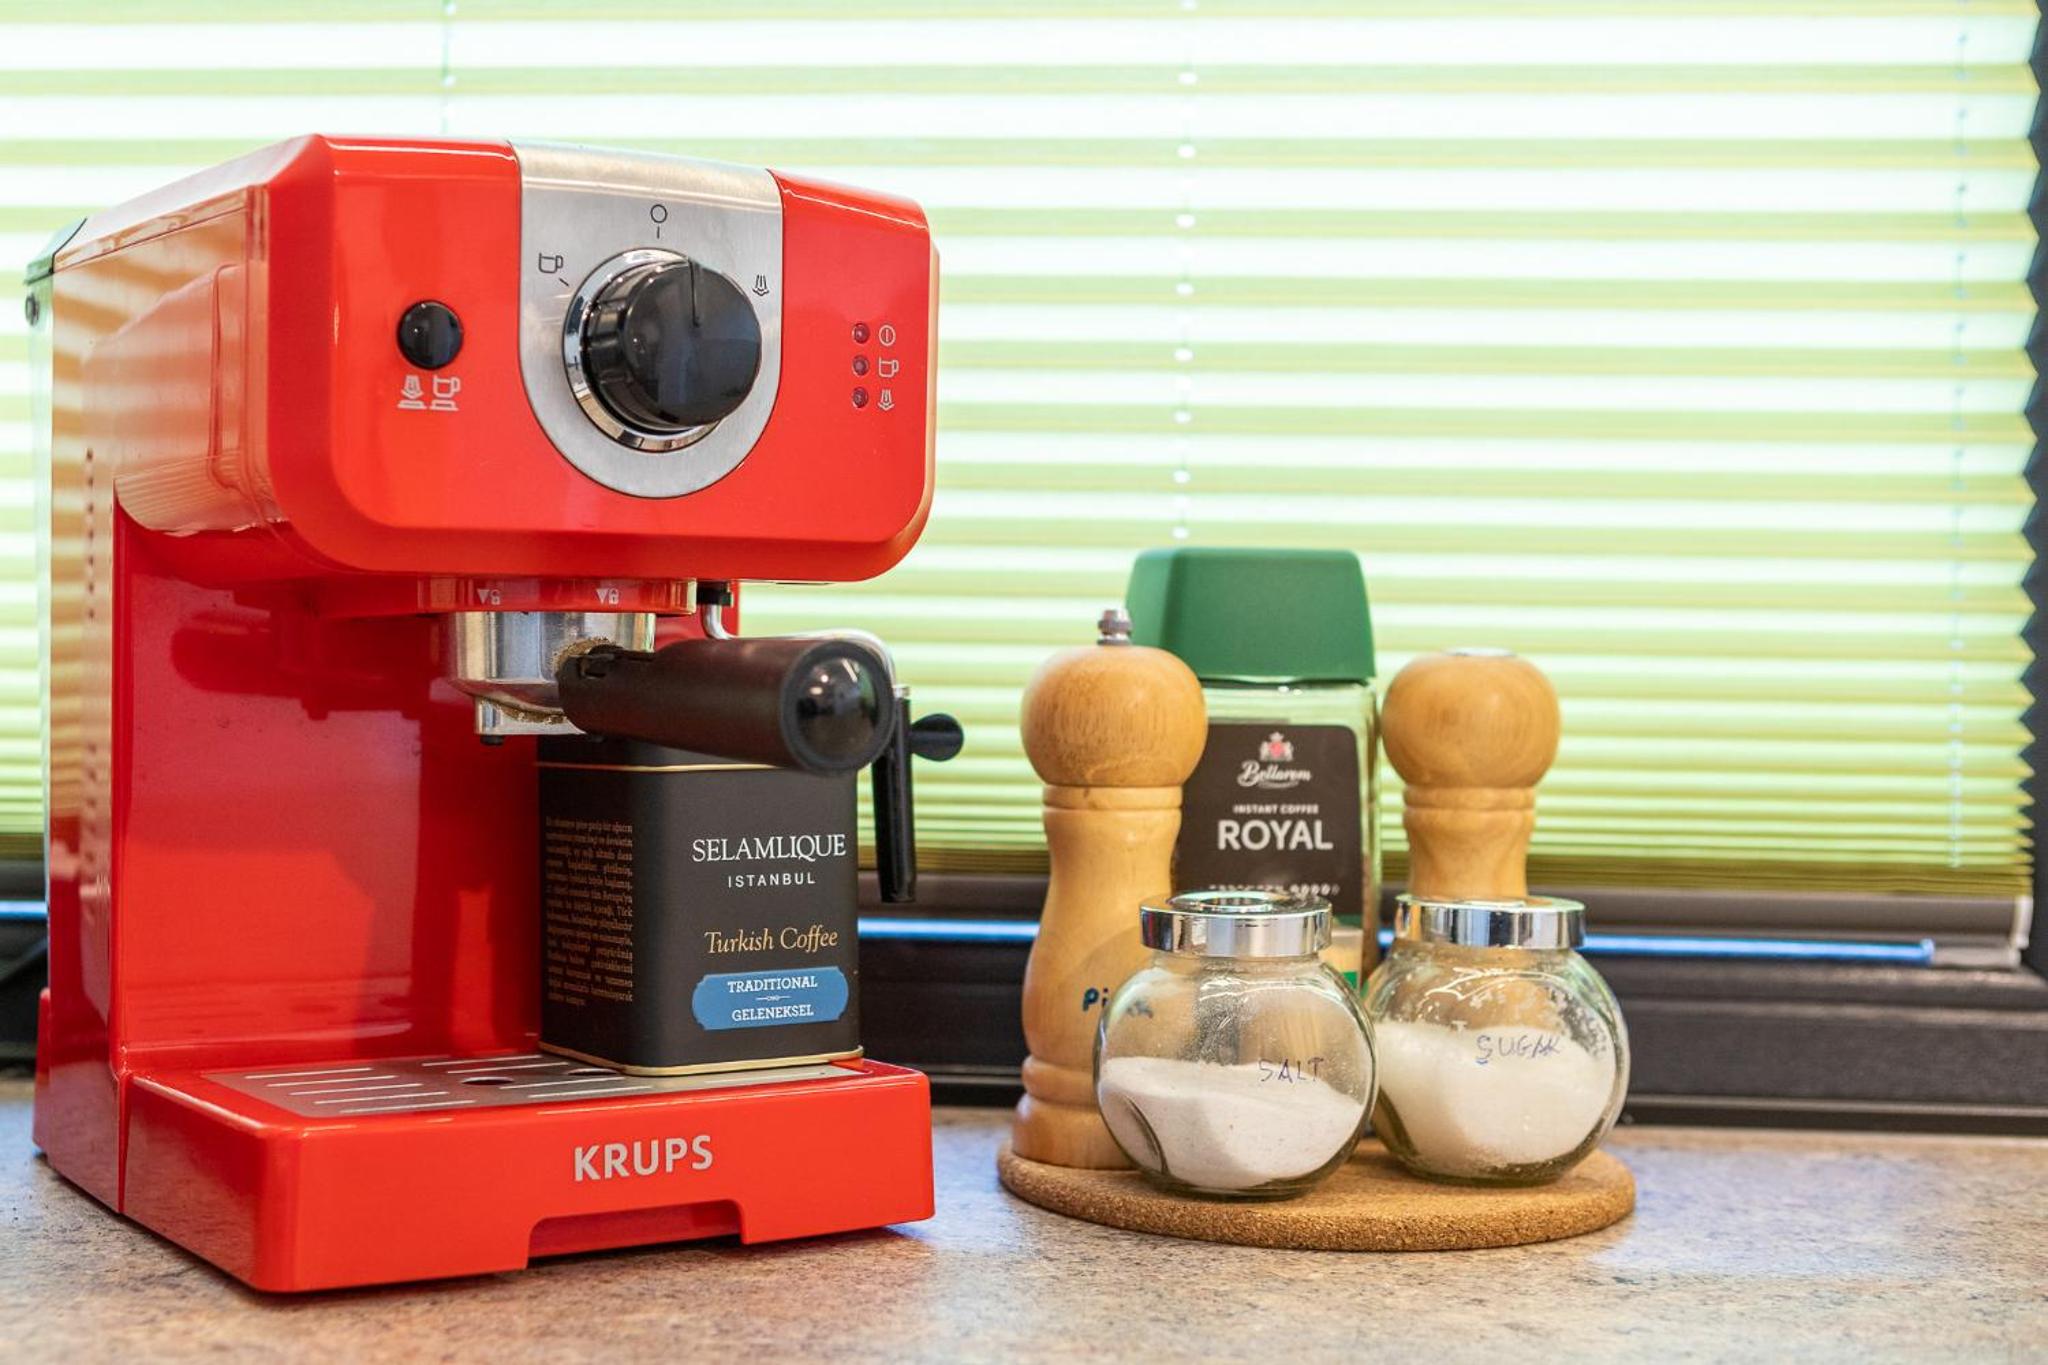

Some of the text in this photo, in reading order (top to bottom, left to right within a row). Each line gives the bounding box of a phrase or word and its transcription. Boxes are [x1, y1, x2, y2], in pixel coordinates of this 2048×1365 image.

[1233, 804, 1319, 815] INSTANT COFFEE
[1217, 819, 1334, 850] ROYAL
[692, 834, 847, 862] SELAMLIQUE
[728, 872, 816, 888] ISTANBUL
[704, 925, 839, 954] Turkish Coffee
[727, 976, 818, 993] TRADITIONAL
[732, 1004, 814, 1022] GELENEKSEL
[1259, 1057, 1324, 1083] SALT
[574, 1134, 714, 1182] KRUPS
